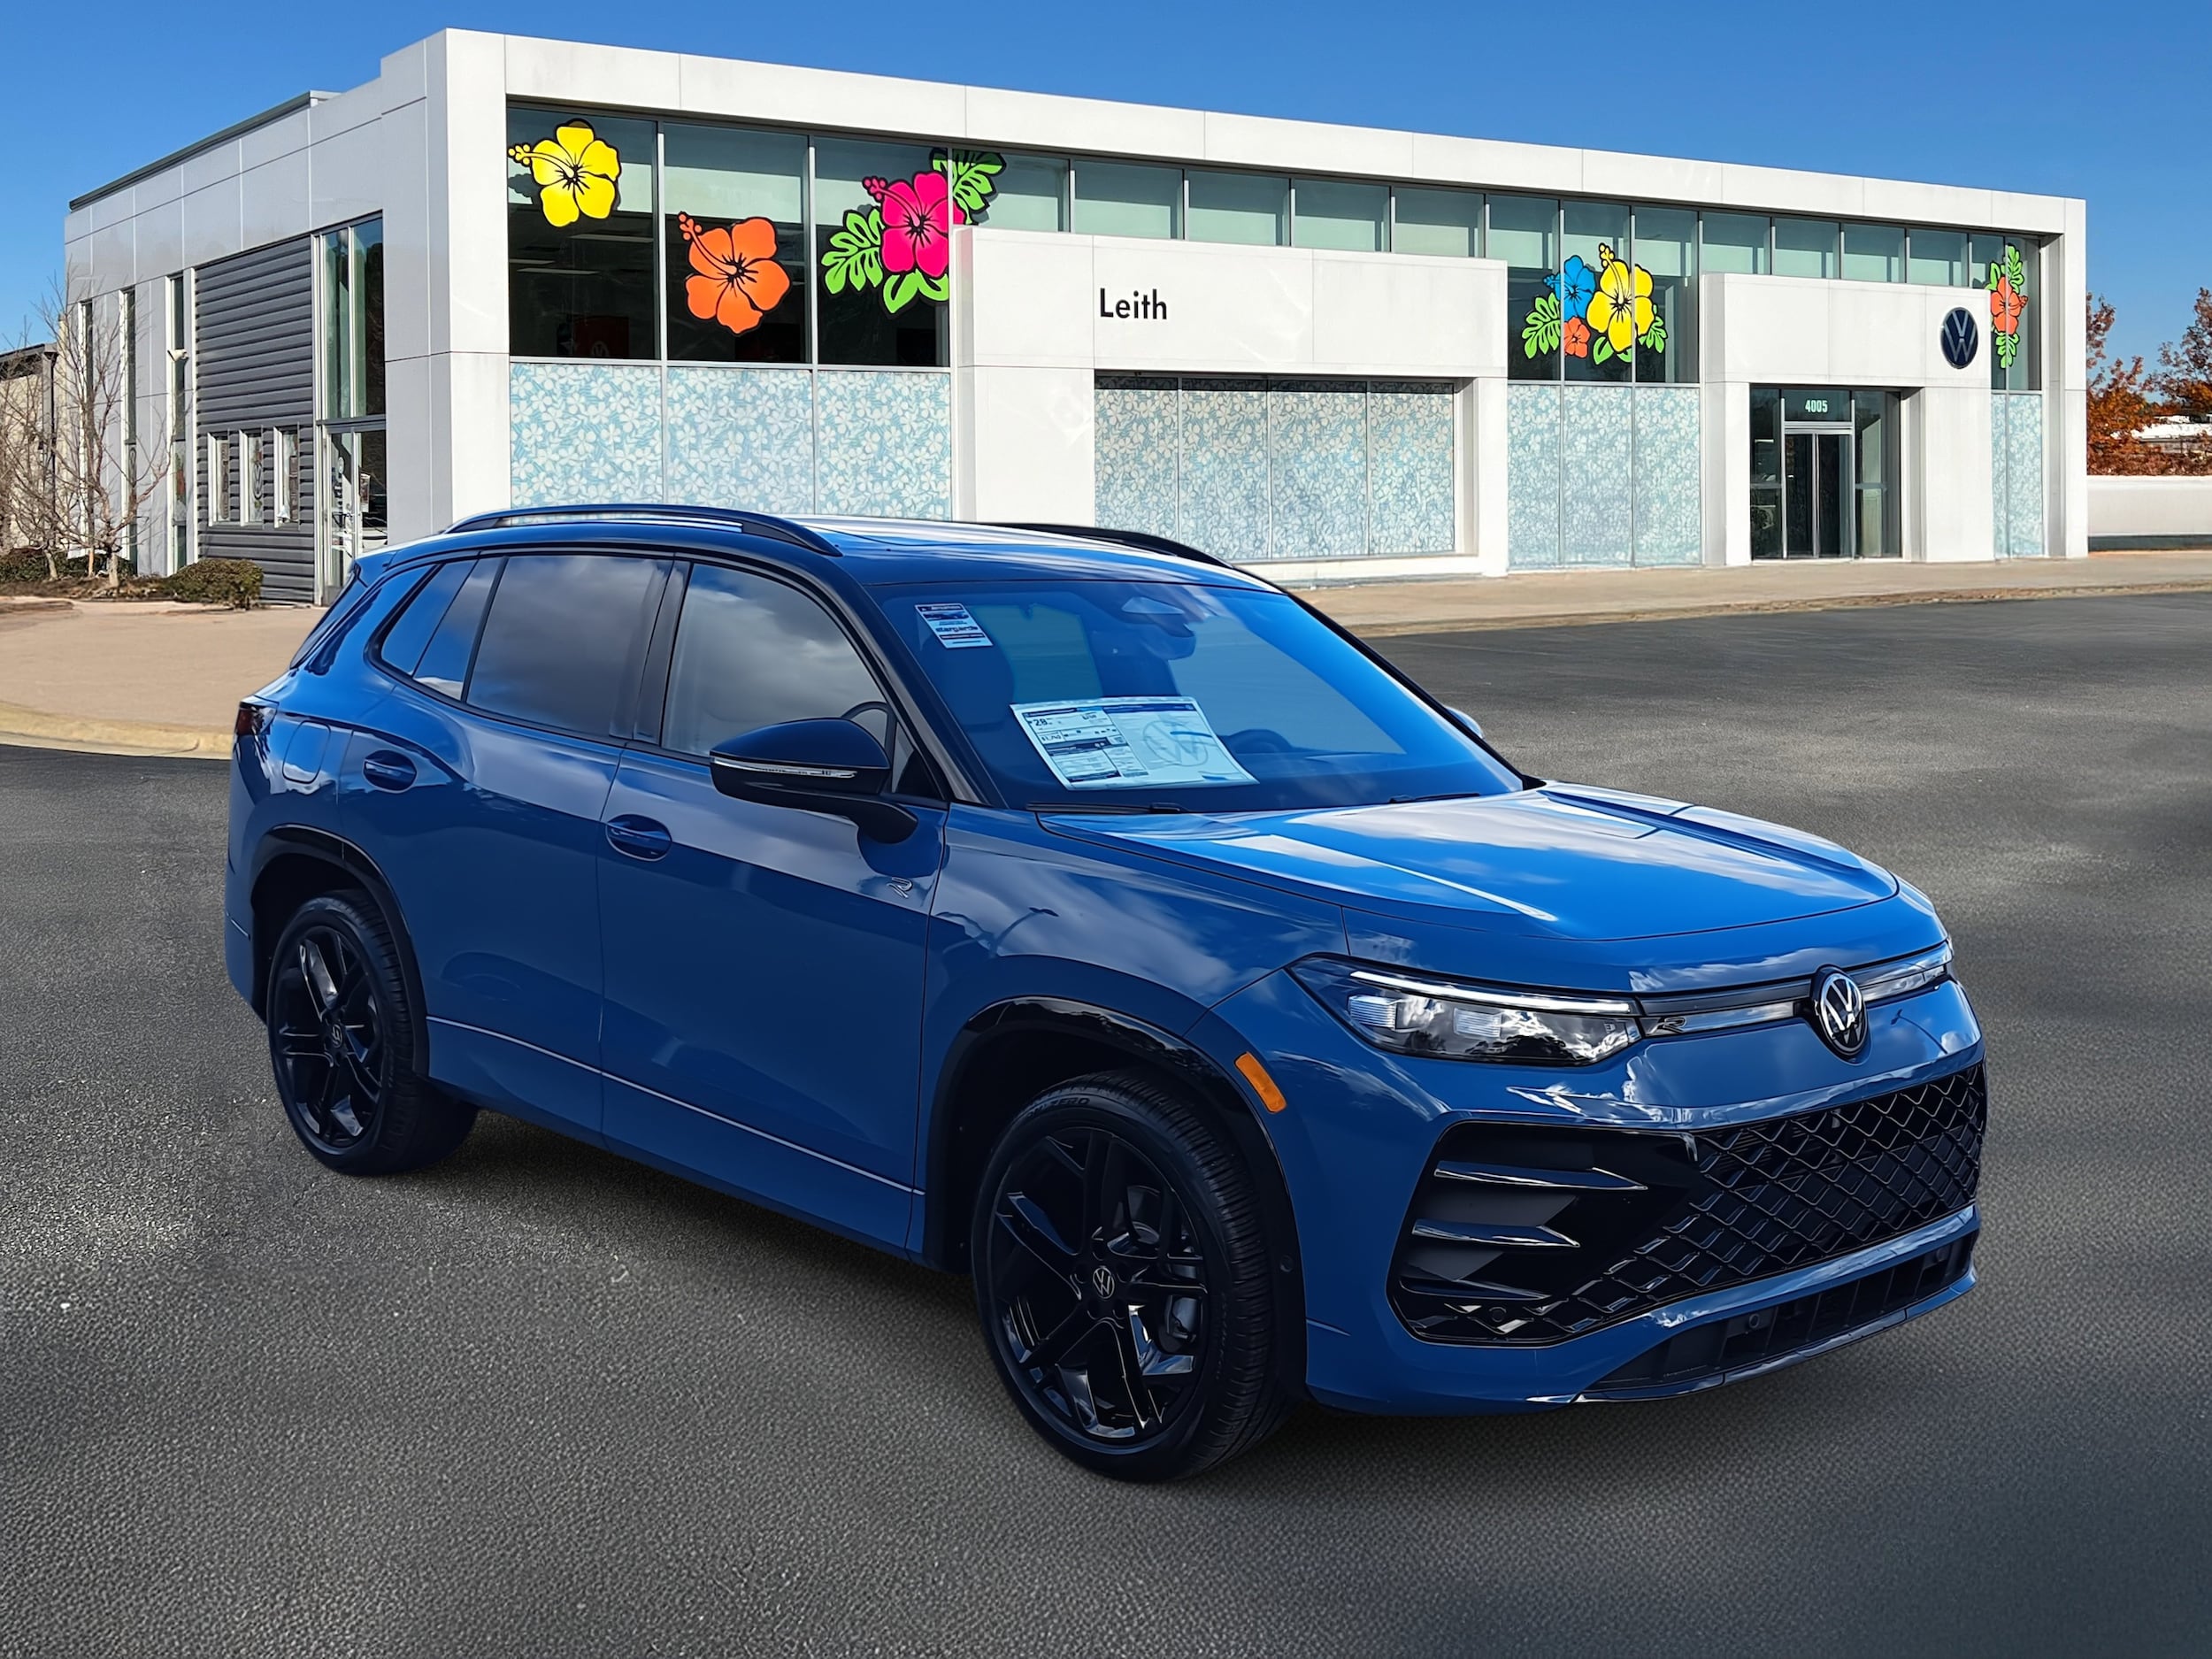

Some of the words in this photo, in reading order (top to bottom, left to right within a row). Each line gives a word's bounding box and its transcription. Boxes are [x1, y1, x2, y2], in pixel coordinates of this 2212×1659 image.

[1100, 288, 1167, 319] Leith
[1942, 309, 1977, 364] VW
[1805, 399, 1828, 413] 4005
[1093, 1267, 1115, 1299] VW
